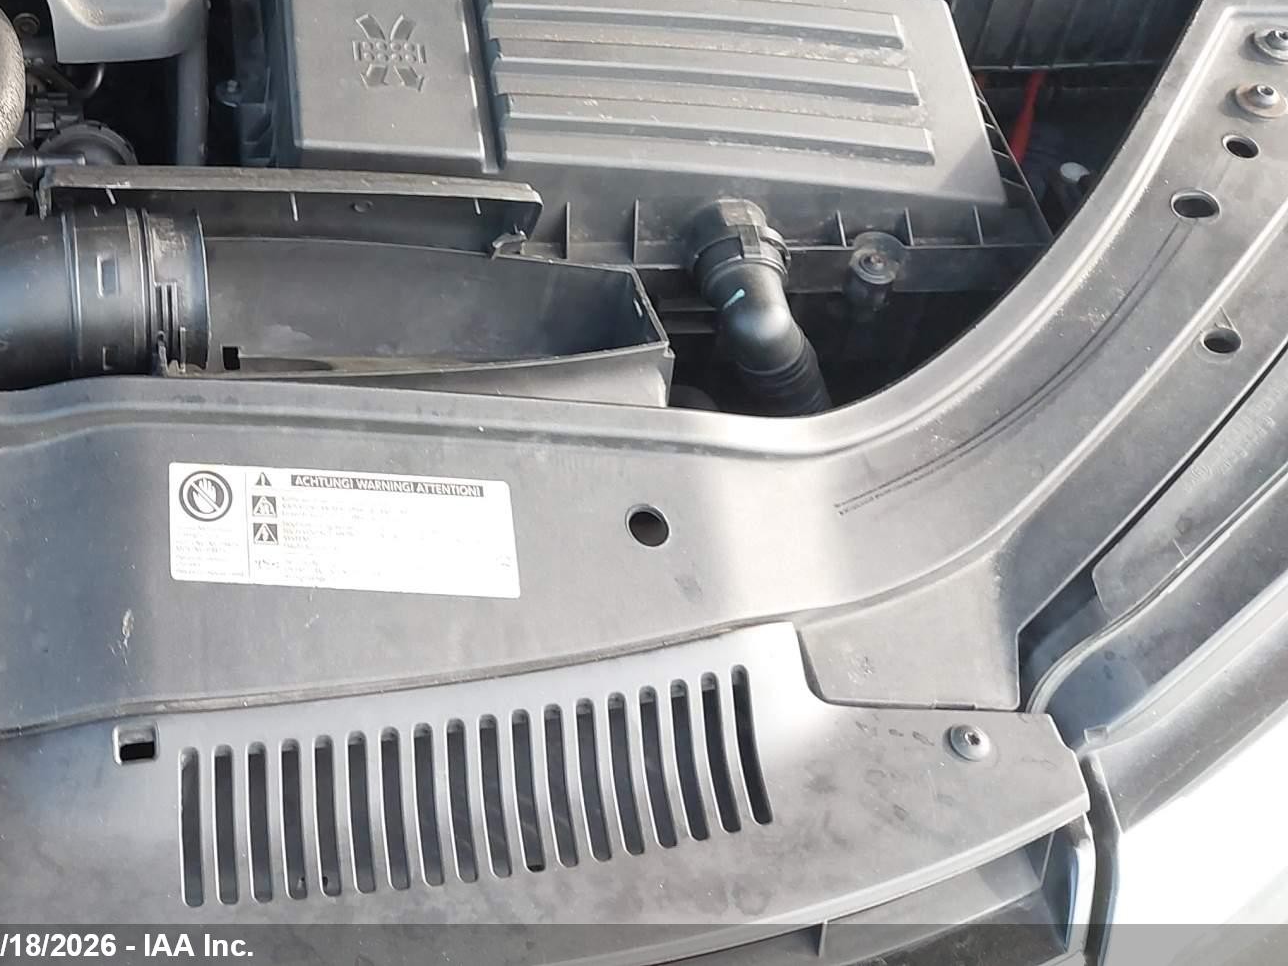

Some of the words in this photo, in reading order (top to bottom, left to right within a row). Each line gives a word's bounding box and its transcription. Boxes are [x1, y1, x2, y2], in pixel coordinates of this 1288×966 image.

[295, 475, 354, 490] ACHTUNG!
[357, 478, 413, 494] WARNING!
[417, 482, 481, 497] ATTENTION!
